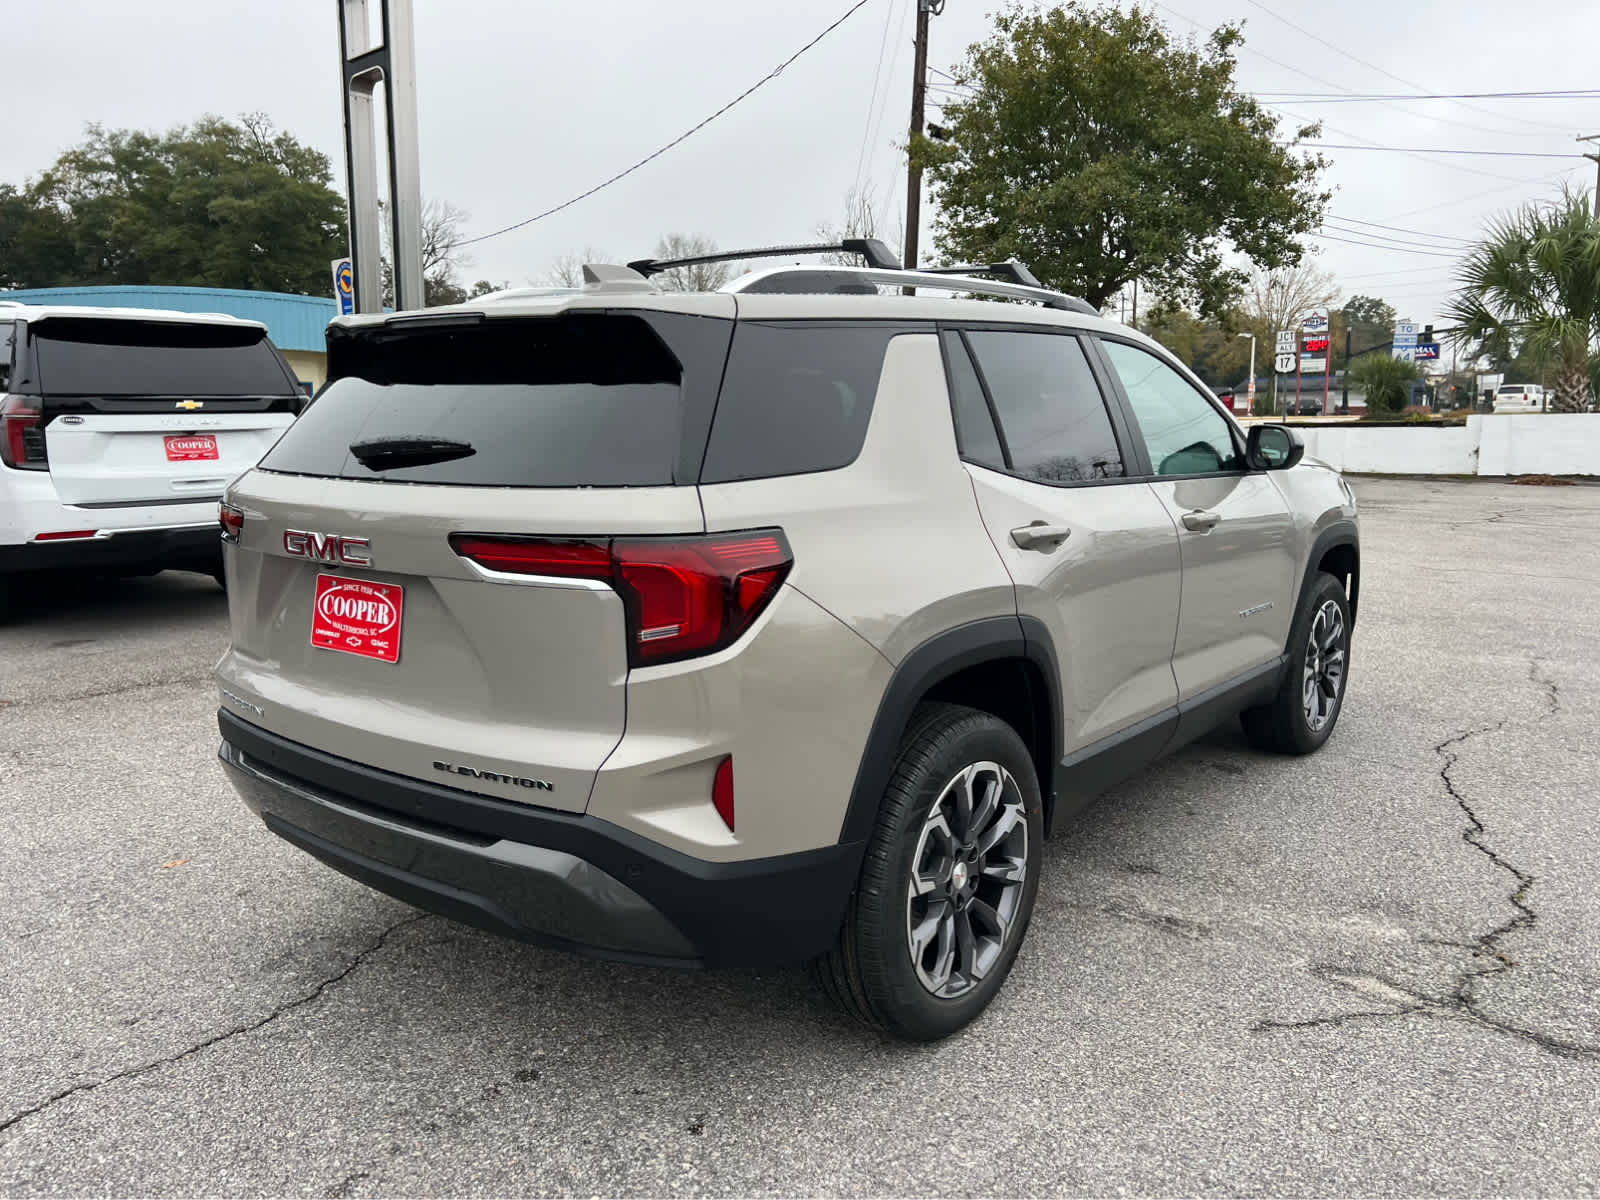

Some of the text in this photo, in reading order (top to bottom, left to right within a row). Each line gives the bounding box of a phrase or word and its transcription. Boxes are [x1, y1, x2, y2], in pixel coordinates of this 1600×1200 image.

[1400, 325, 1413, 333] TO
[1279, 331, 1294, 341] JCT
[1280, 357, 1291, 369] 17
[170, 440, 212, 449] COOPER
[283, 528, 372, 568] GMC
[322, 594, 390, 625] COOPER
[432, 760, 554, 792] ELEVATION
